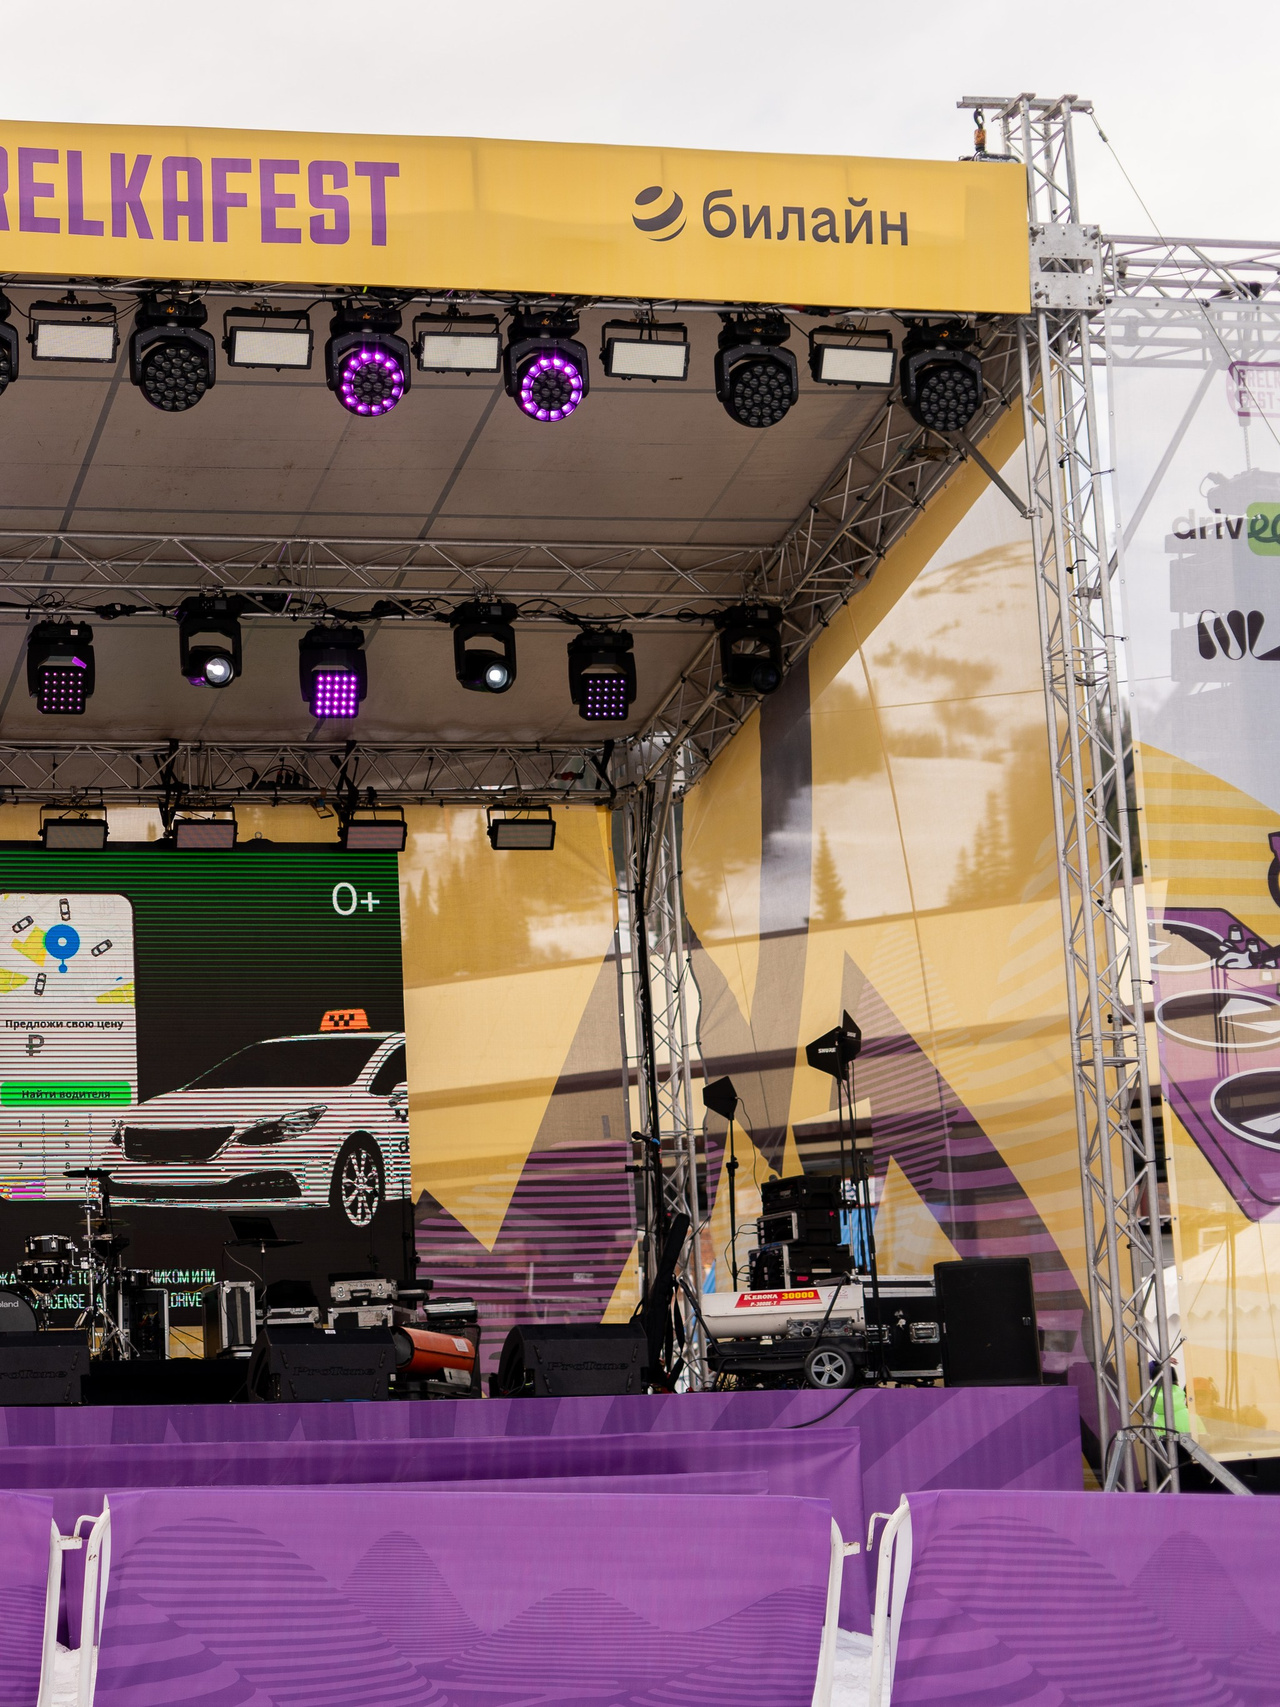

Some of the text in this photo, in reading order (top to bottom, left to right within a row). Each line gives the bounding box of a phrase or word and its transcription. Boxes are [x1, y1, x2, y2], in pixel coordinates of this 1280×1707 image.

[701, 189, 908, 247] билайн
[1237, 369, 1280, 388] GRELK
[332, 882, 380, 916] 0+
[5, 1019, 124, 1031] Предложи свою цену
[21, 1089, 111, 1101] Найти водителя
[191, 1268, 216, 1284] ИЛИ
[781, 1291, 815, 1300] 30000
[293, 1366, 376, 1376] ProTone
[547, 1361, 629, 1371] ProTone
